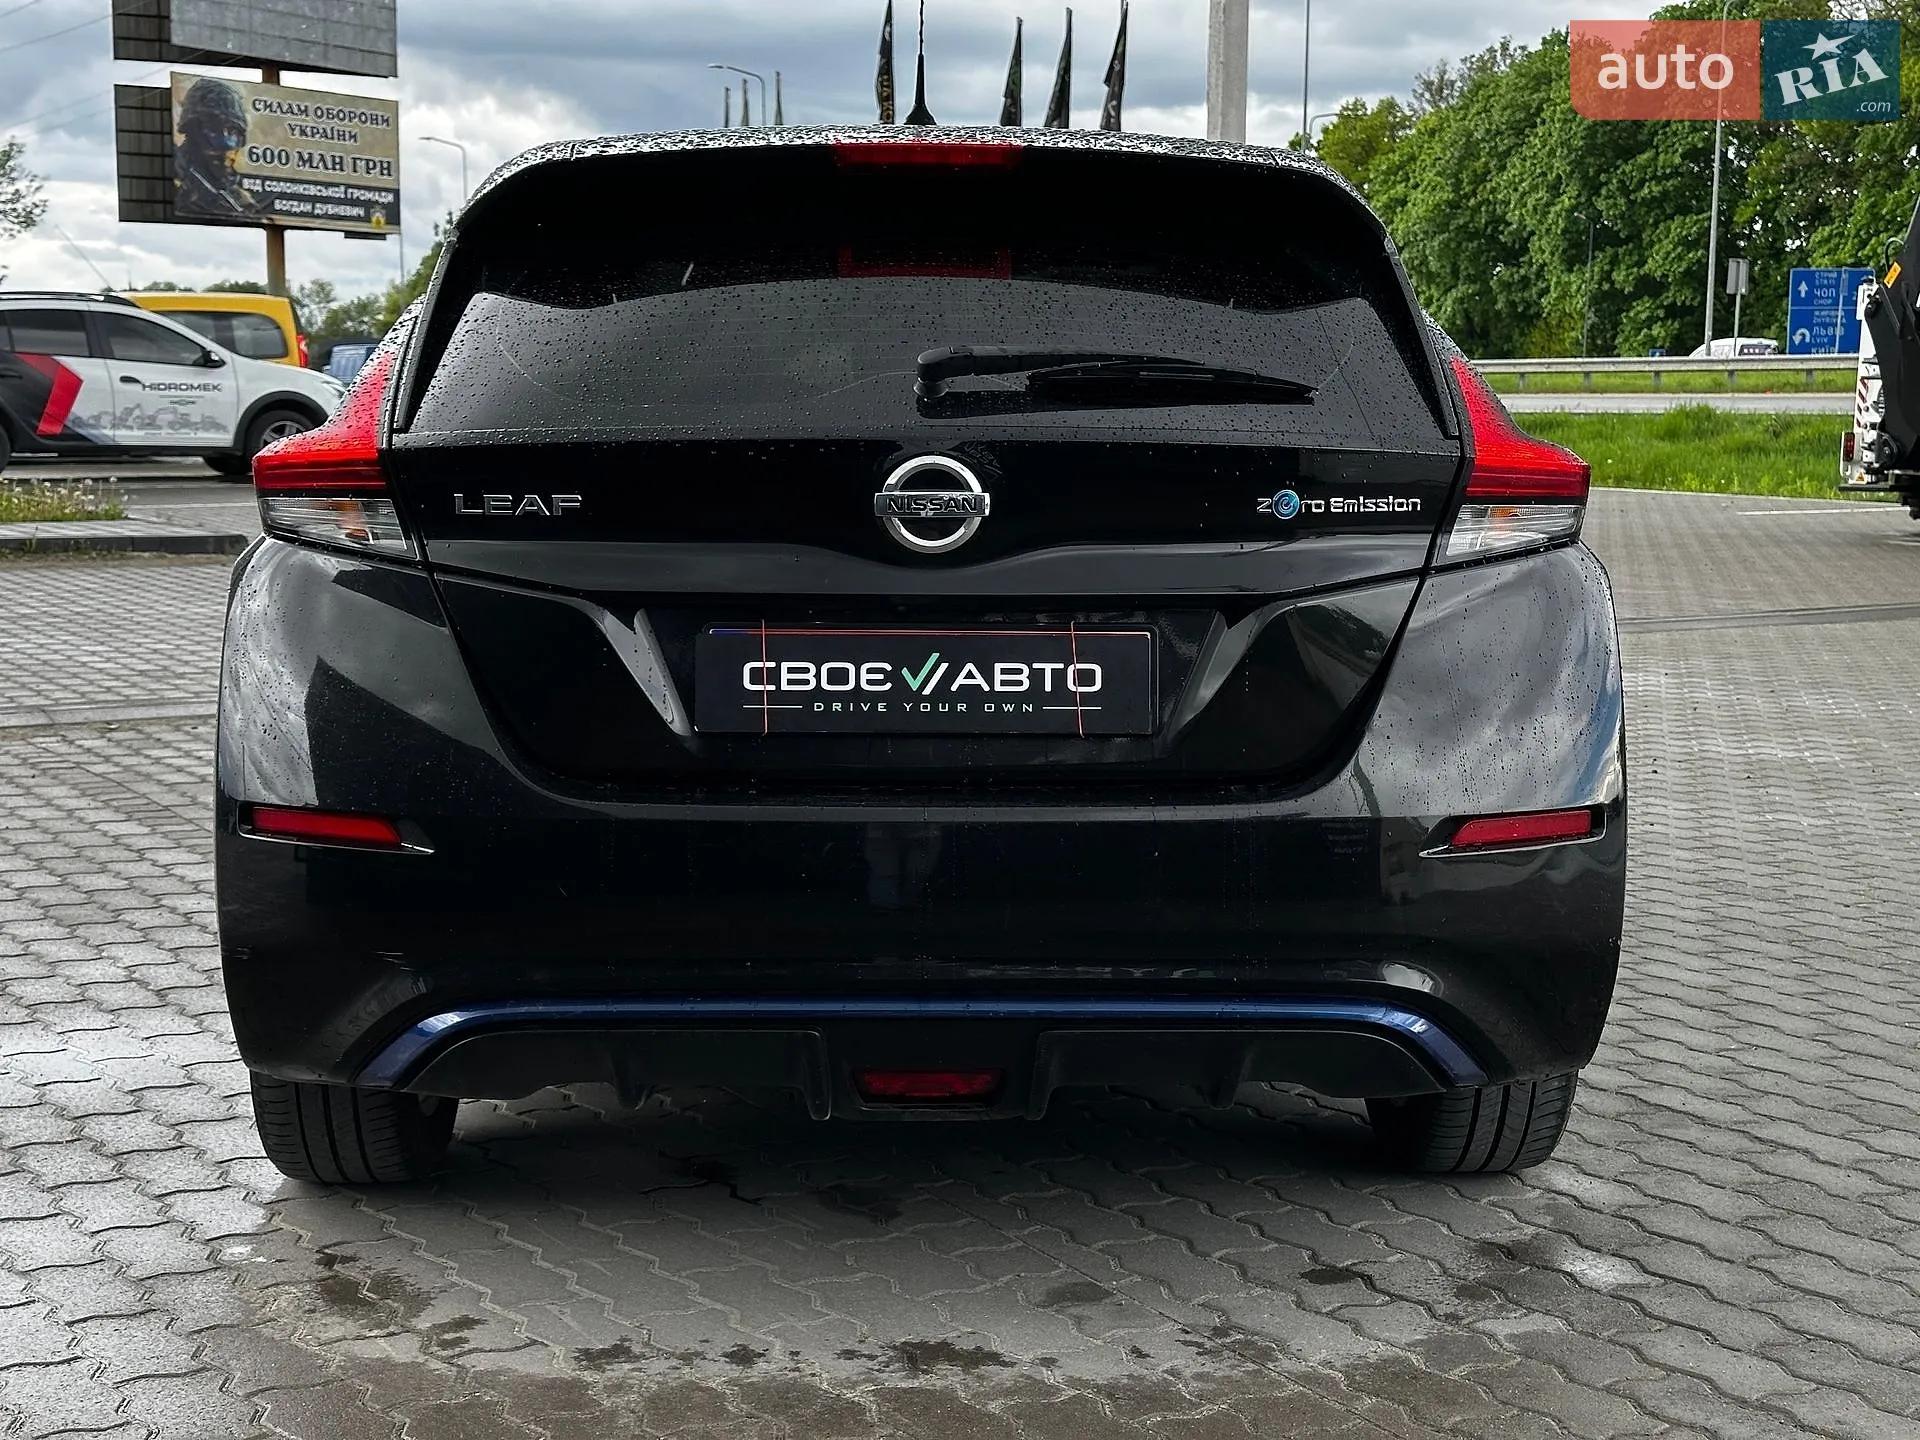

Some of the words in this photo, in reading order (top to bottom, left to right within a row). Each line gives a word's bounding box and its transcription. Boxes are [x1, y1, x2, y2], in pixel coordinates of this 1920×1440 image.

[252, 98, 310, 118] СИЛАМ
[314, 105, 391, 128] ОБОРОНИ
[287, 122, 358, 144] УКРАЇНИ
[247, 146, 290, 169] 600
[296, 150, 346, 173] МЛН
[351, 156, 393, 178] ГРН
[1813, 288, 1836, 298] ЧОП
[453, 493, 583, 516] LEAF
[886, 495, 978, 513] NISSAN
[1329, 495, 1421, 513] Emission
[950, 662, 1102, 692] АВТО
[813, 702, 887, 712] DRIVE
[903, 702, 968, 713] YOUR
[984, 702, 1033, 713] OWN
